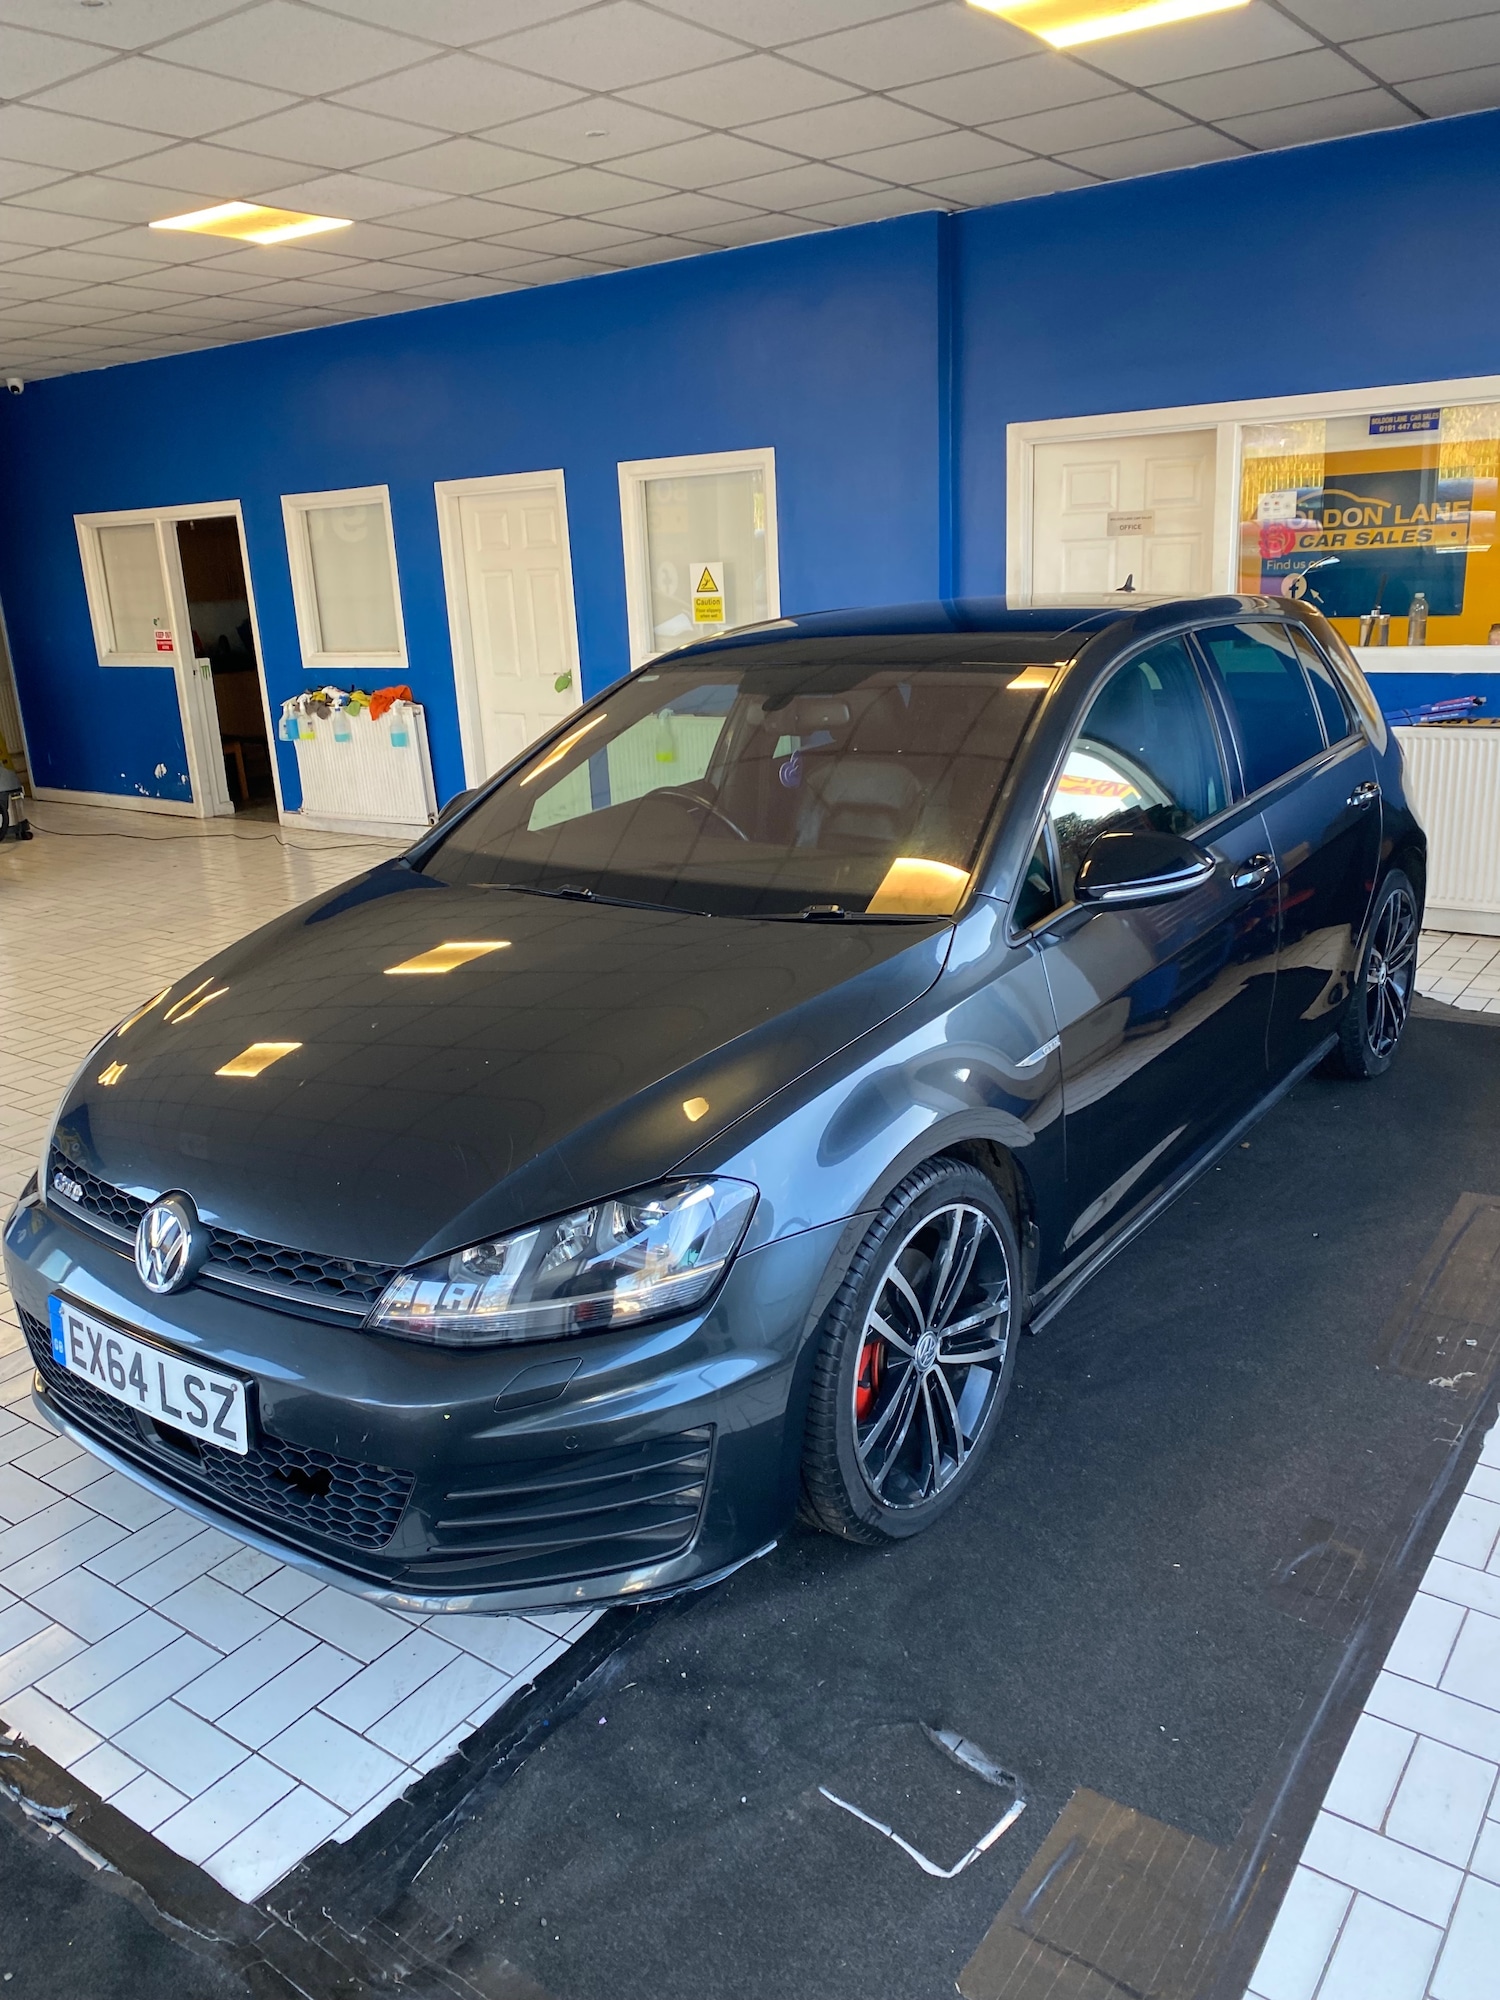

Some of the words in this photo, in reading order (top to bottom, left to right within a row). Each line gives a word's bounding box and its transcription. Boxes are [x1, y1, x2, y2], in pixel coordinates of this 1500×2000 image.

[1423, 412, 1440, 420] SALES
[1379, 424, 1396, 432] 0191
[1286, 506, 1383, 530] OLDON
[1394, 500, 1471, 525] LANE
[1299, 533, 1347, 550] CAR
[1354, 528, 1434, 546] SALES
[1266, 558, 1291, 571] Find
[1293, 561, 1306, 570] us
[696, 598, 720, 606] Caution
[54, 1338, 64, 1354] GB
[68, 1315, 149, 1403] EX64
[157, 1361, 237, 1442] LSZ
